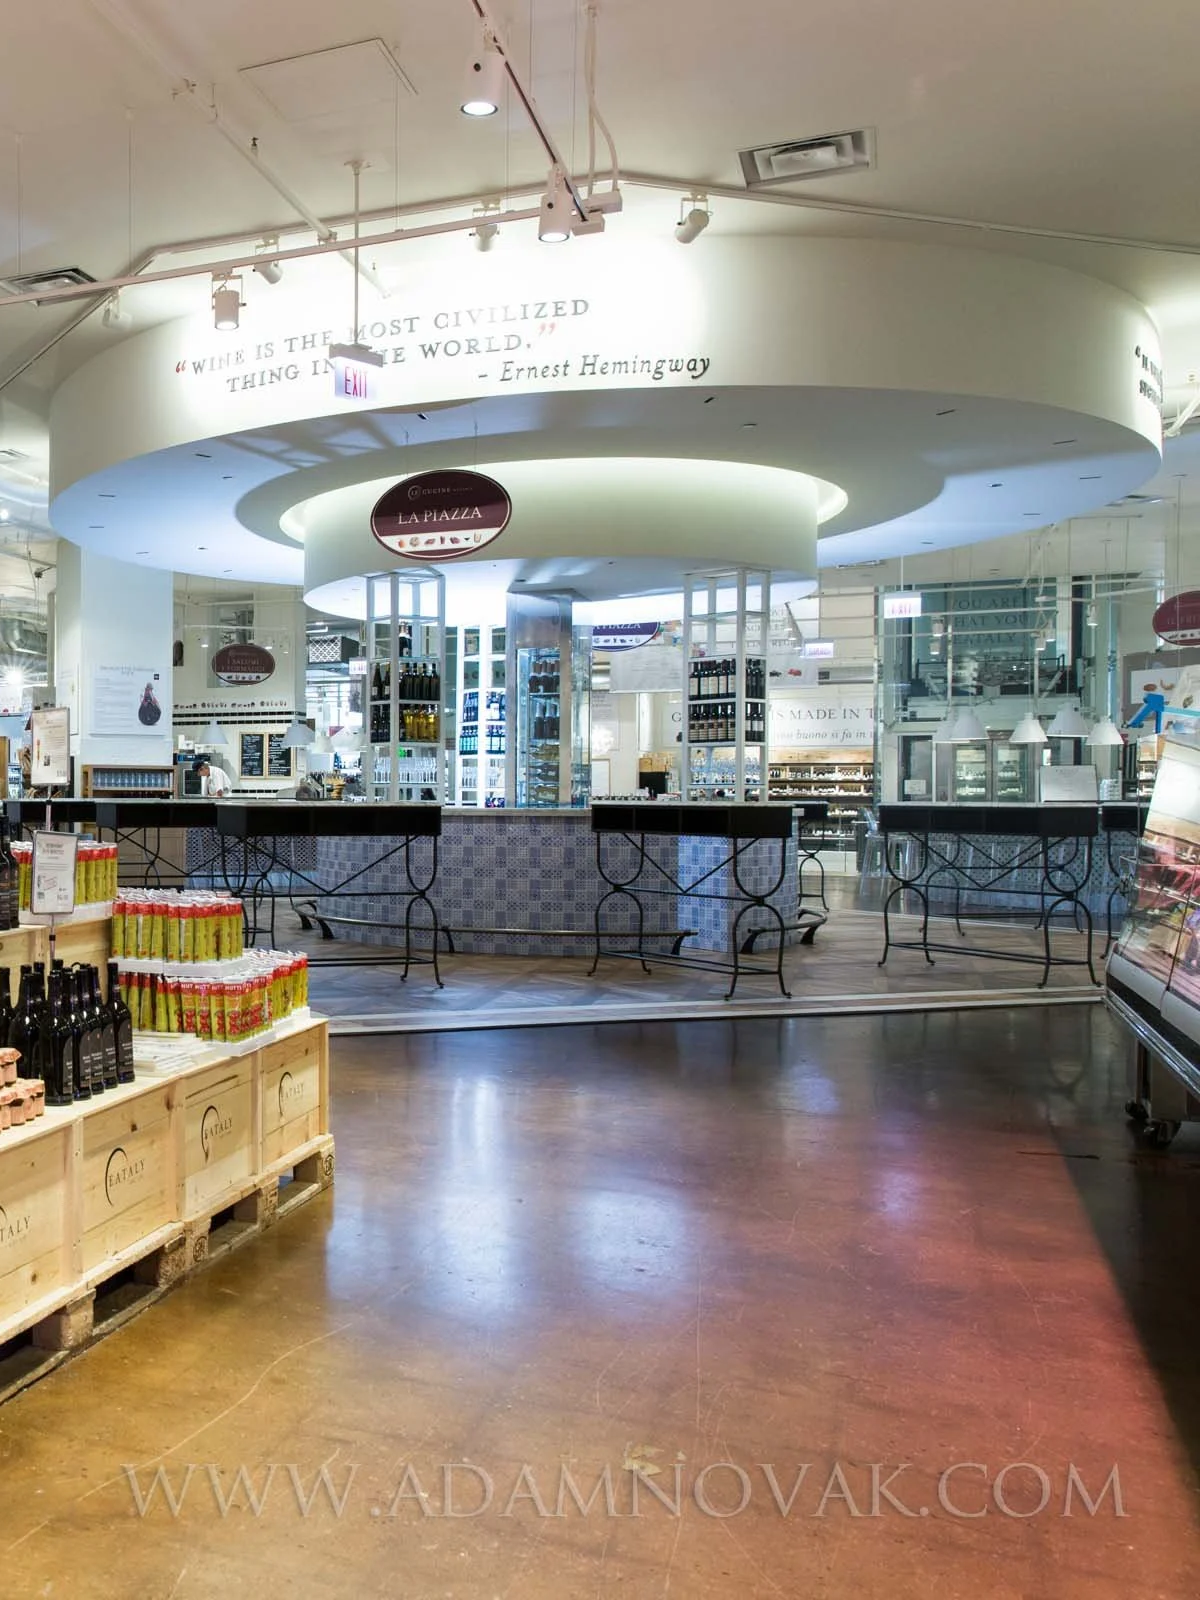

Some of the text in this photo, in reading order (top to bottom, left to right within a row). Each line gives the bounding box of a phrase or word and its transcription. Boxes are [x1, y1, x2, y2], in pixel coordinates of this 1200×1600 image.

[255, 342, 274, 361] IS
[284, 330, 333, 354] THE
[348, 316, 420, 344] MOST
[433, 299, 589, 330] CIVILIZED
[226, 364, 300, 393] THING
[344, 366, 369, 398] EXIT
[499, 360, 570, 382] Ernest
[578, 354, 711, 381] Hemingway
[398, 506, 483, 525] LA PIAZZA
[789, 708, 837, 720] MADE
[842, 707, 860, 719] IN
[204, 1117, 232, 1141] EATALY
[109, 1159, 145, 1188] EATALY
